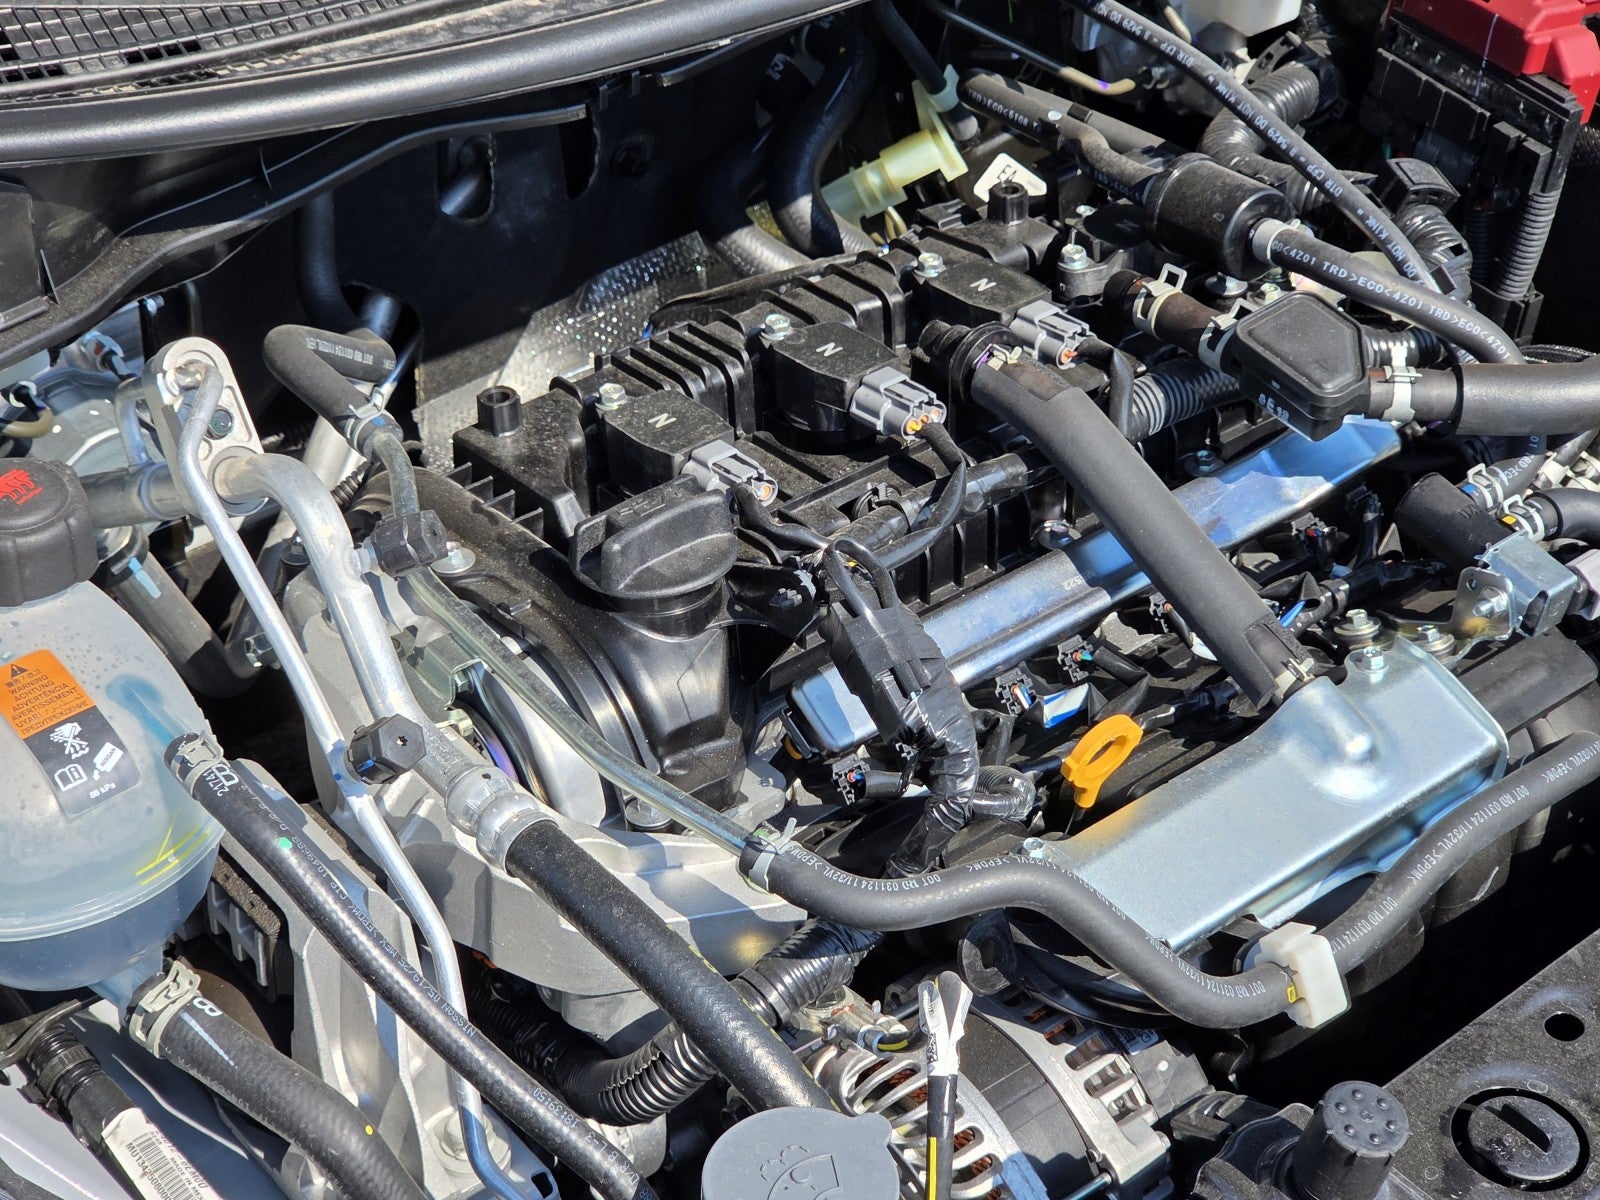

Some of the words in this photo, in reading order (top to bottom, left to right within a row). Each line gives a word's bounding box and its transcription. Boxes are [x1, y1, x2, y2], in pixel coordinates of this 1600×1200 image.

[1364, 215, 1389, 240] KINK
[9, 674, 49, 695] WARNING
[14, 681, 55, 702] ACHTUNG
[11, 687, 79, 721] AVERTISSEMENT
[12, 682, 70, 713] ADVERTÊNCIA
[822, 865, 858, 887] 11/32VL
[860, 879, 899, 892] 031124
[922, 873, 942, 887] DOT
[441, 1003, 477, 1038] NISSAN
